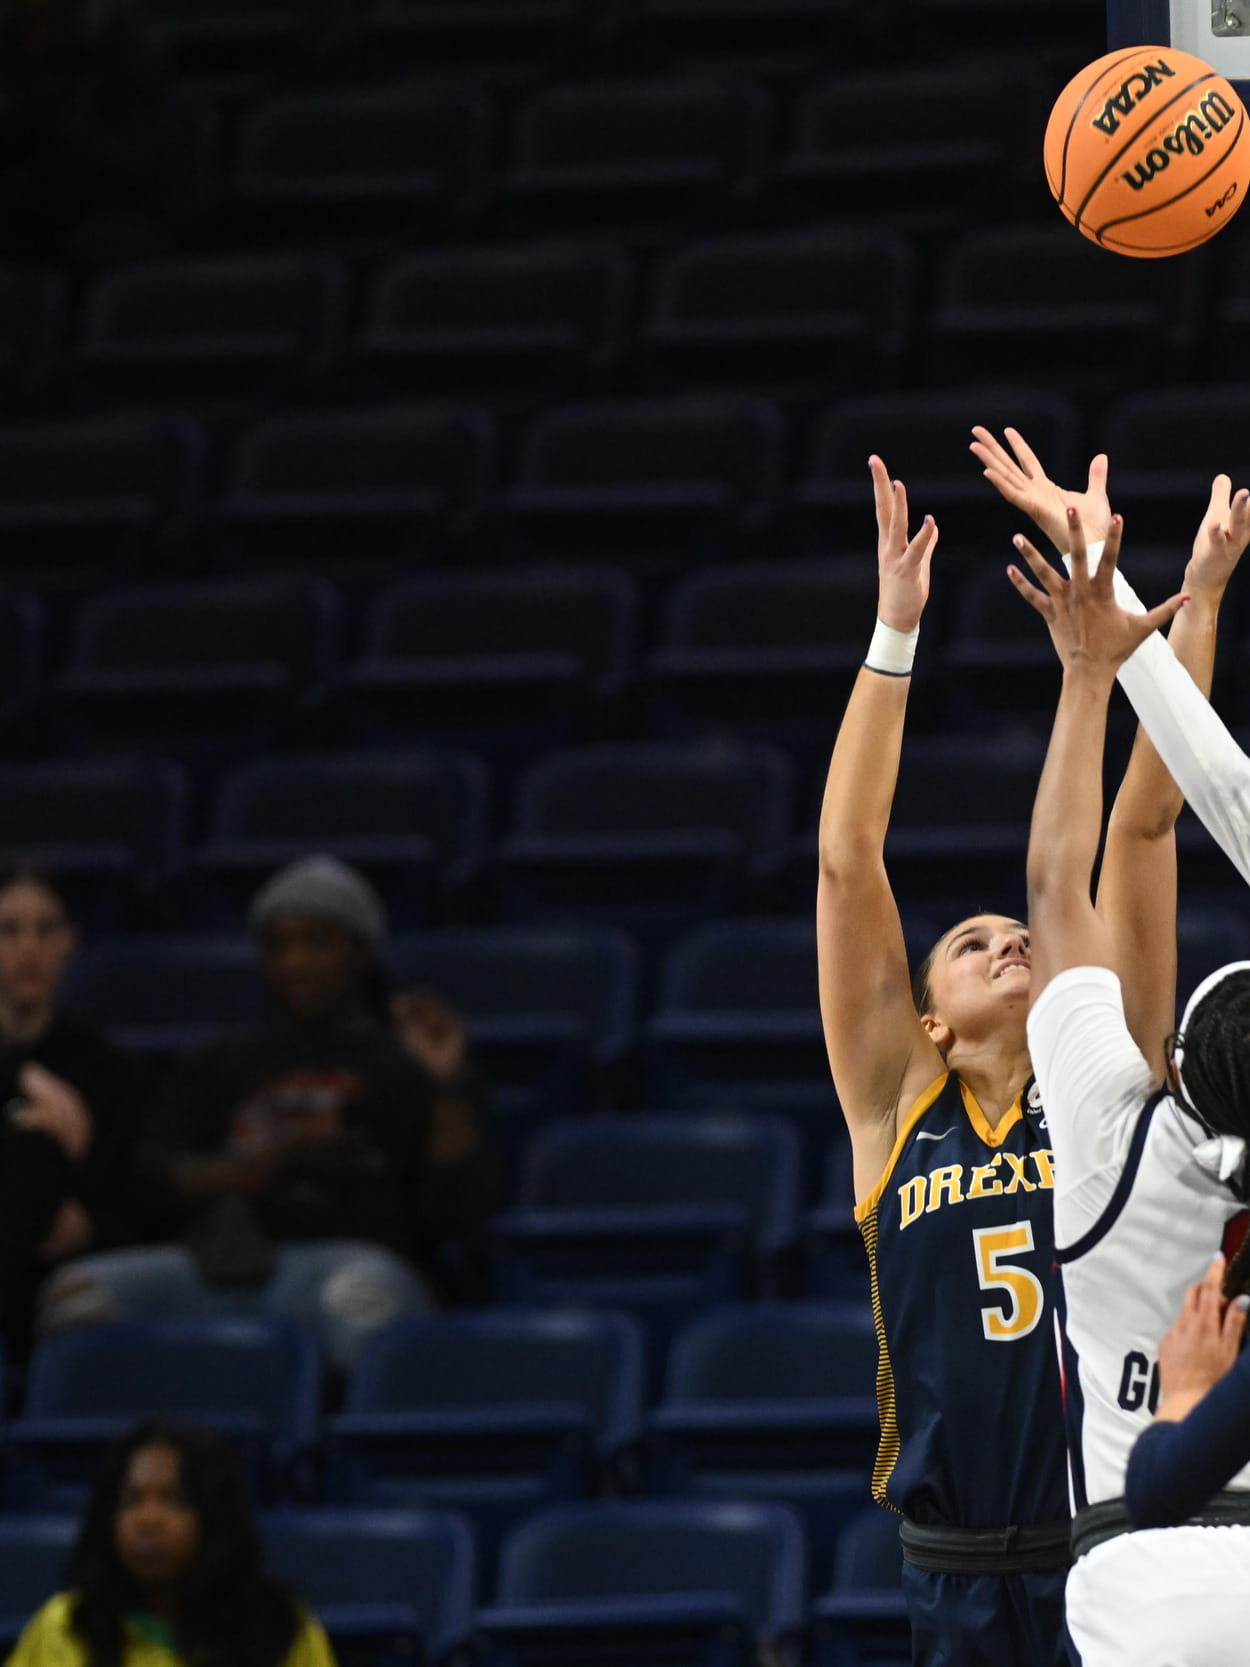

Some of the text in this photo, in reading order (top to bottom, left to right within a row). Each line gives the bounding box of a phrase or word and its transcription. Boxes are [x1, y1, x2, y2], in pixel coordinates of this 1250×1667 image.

[1092, 58, 1176, 136] NCAA
[1120, 90, 1235, 191] Wilson
[898, 1148, 1056, 1231] DREXE
[972, 1219, 1044, 1342] 5
